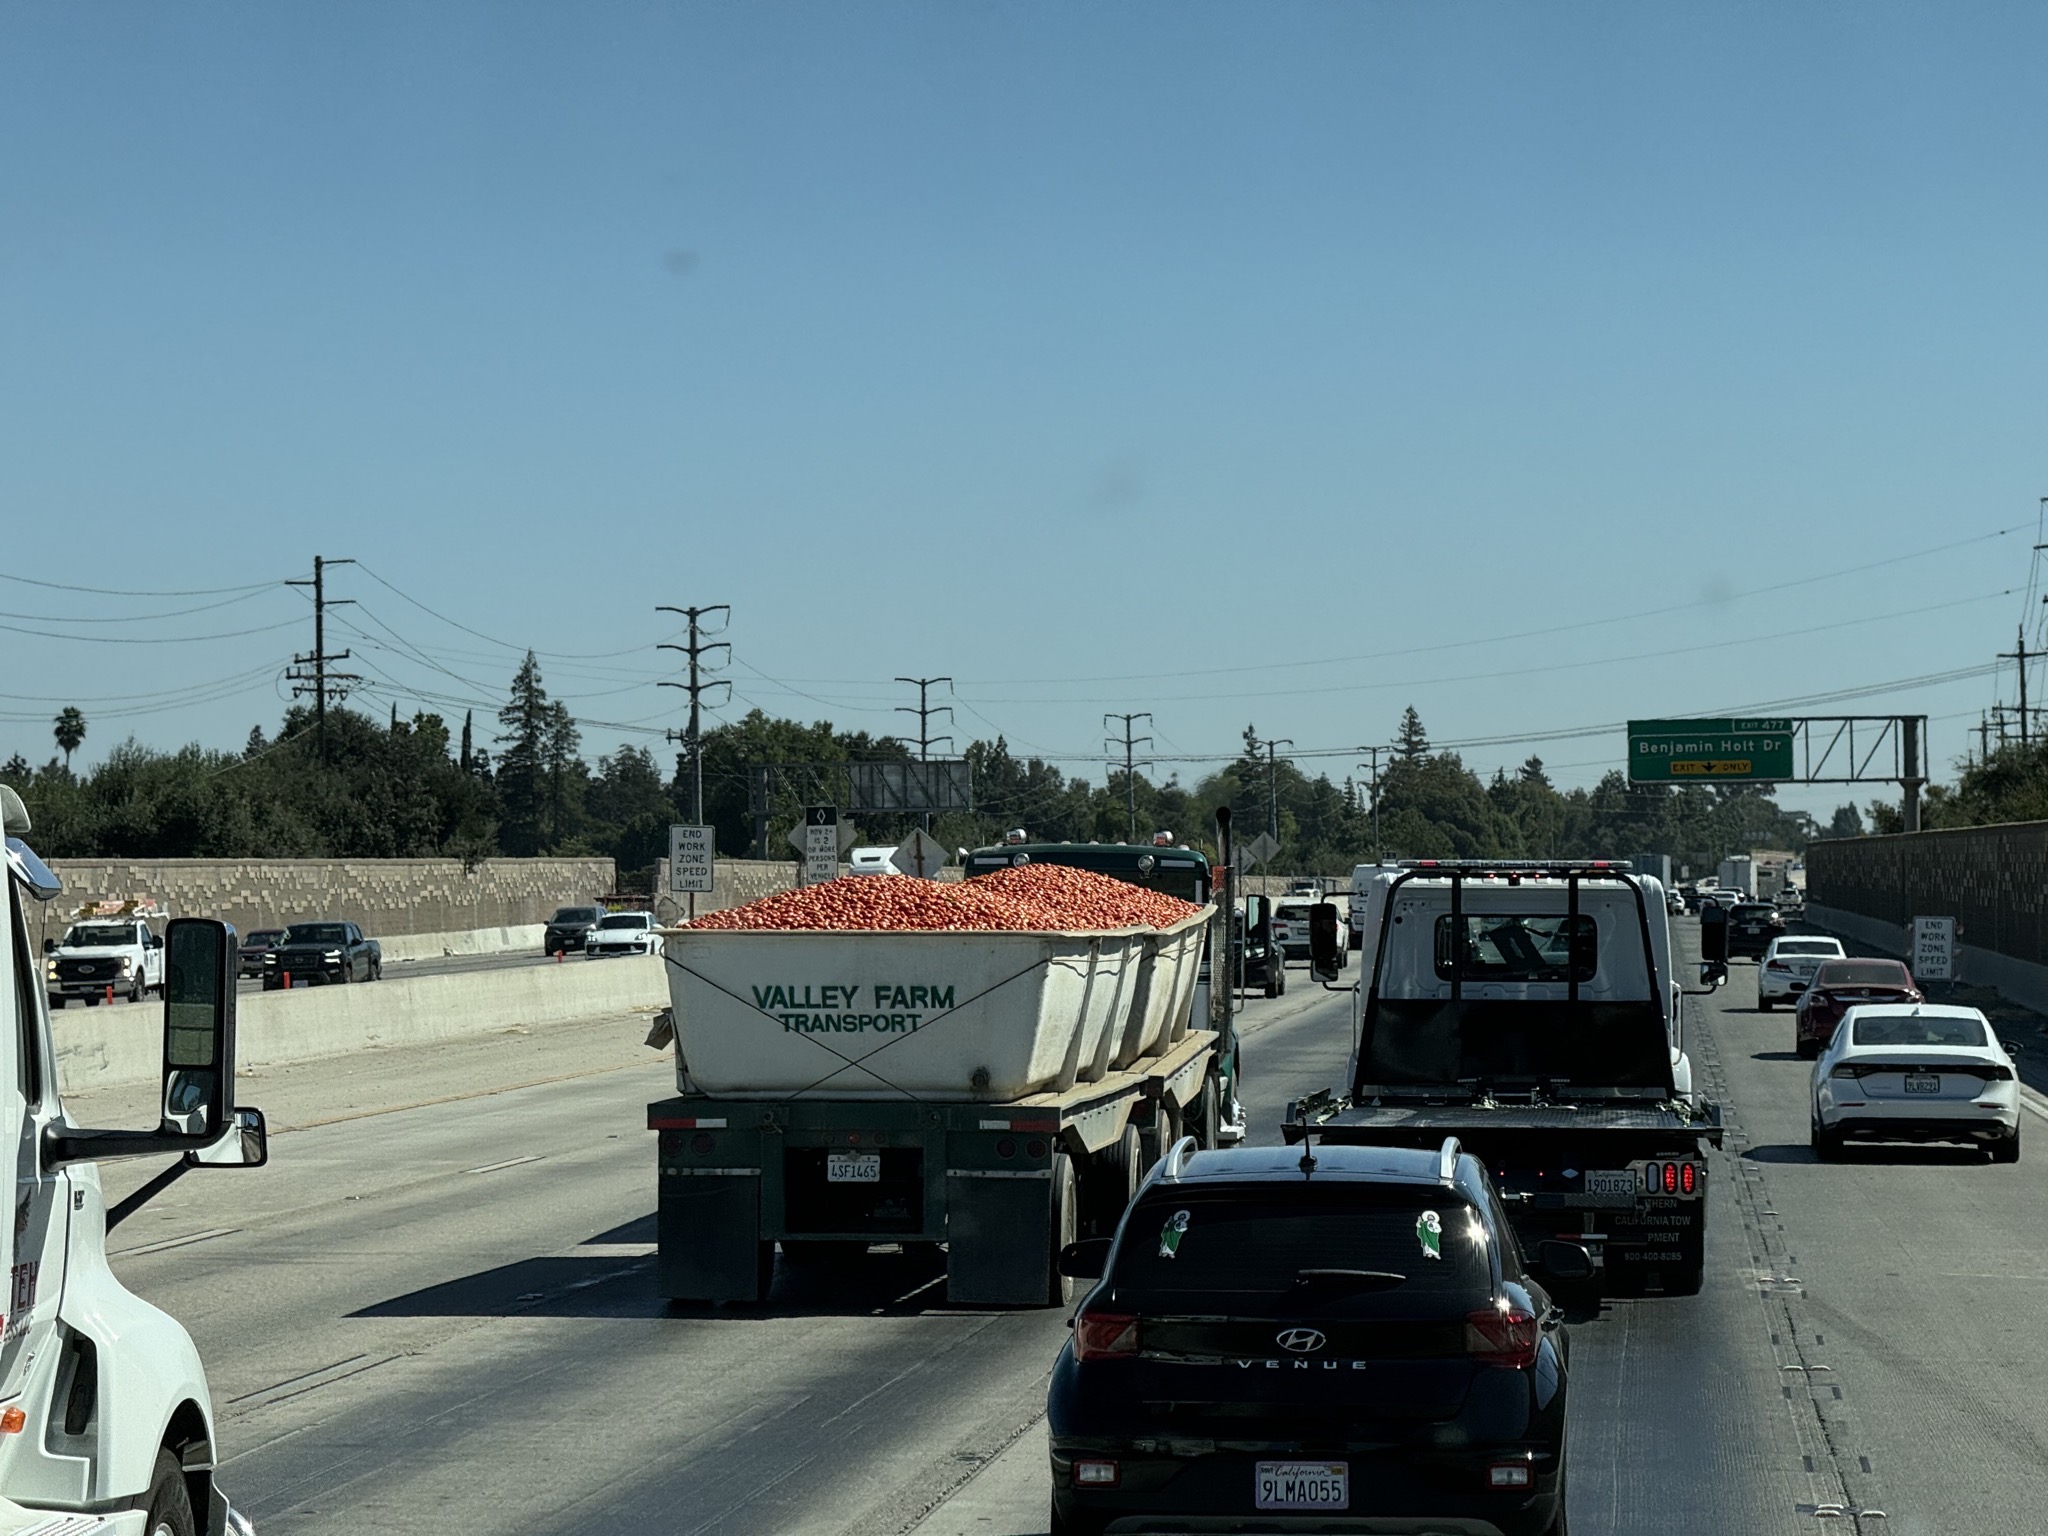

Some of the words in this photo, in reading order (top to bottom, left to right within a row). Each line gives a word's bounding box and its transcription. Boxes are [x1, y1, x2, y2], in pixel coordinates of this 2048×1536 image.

[1741, 721, 1759, 730] EXIT
[1761, 720, 1785, 730] 477
[1639, 741, 1714, 756] Benjamin
[1721, 740, 1755, 751] Holt
[1763, 739, 1782, 751] Dr
[1672, 763, 1696, 772] EXIT
[1722, 762, 1749, 772] ONLY
[682, 829, 702, 839] END
[678, 842, 706, 851] WORK
[678, 854, 705, 864] ZONE
[676, 867, 708, 876] SPEED
[816, 863, 829, 871] PER
[679, 880, 704, 889] LIMIT
[1925, 921, 1943, 930] END
[1921, 932, 1947, 941] WORK
[1921, 944, 1945, 953] ZONE
[1918, 956, 1948, 965] SPEED
[1921, 968, 1944, 976] LIMIT
[752, 985, 860, 1009] VALLEY
[874, 985, 955, 1009] FARM
[778, 1014, 923, 1033] TRANSPORT
[831, 1164, 877, 1178] 4SF1465
[1587, 1179, 1633, 1192] 19018Z3
[1615, 1216, 1669, 1226] CALIFORNIA
[1670, 1215, 1692, 1225] TOW
[1237, 1360, 1367, 1370] VENUE
[1274, 1465, 1332, 1480] California
[1262, 1480, 1342, 1502] 9LMA055
